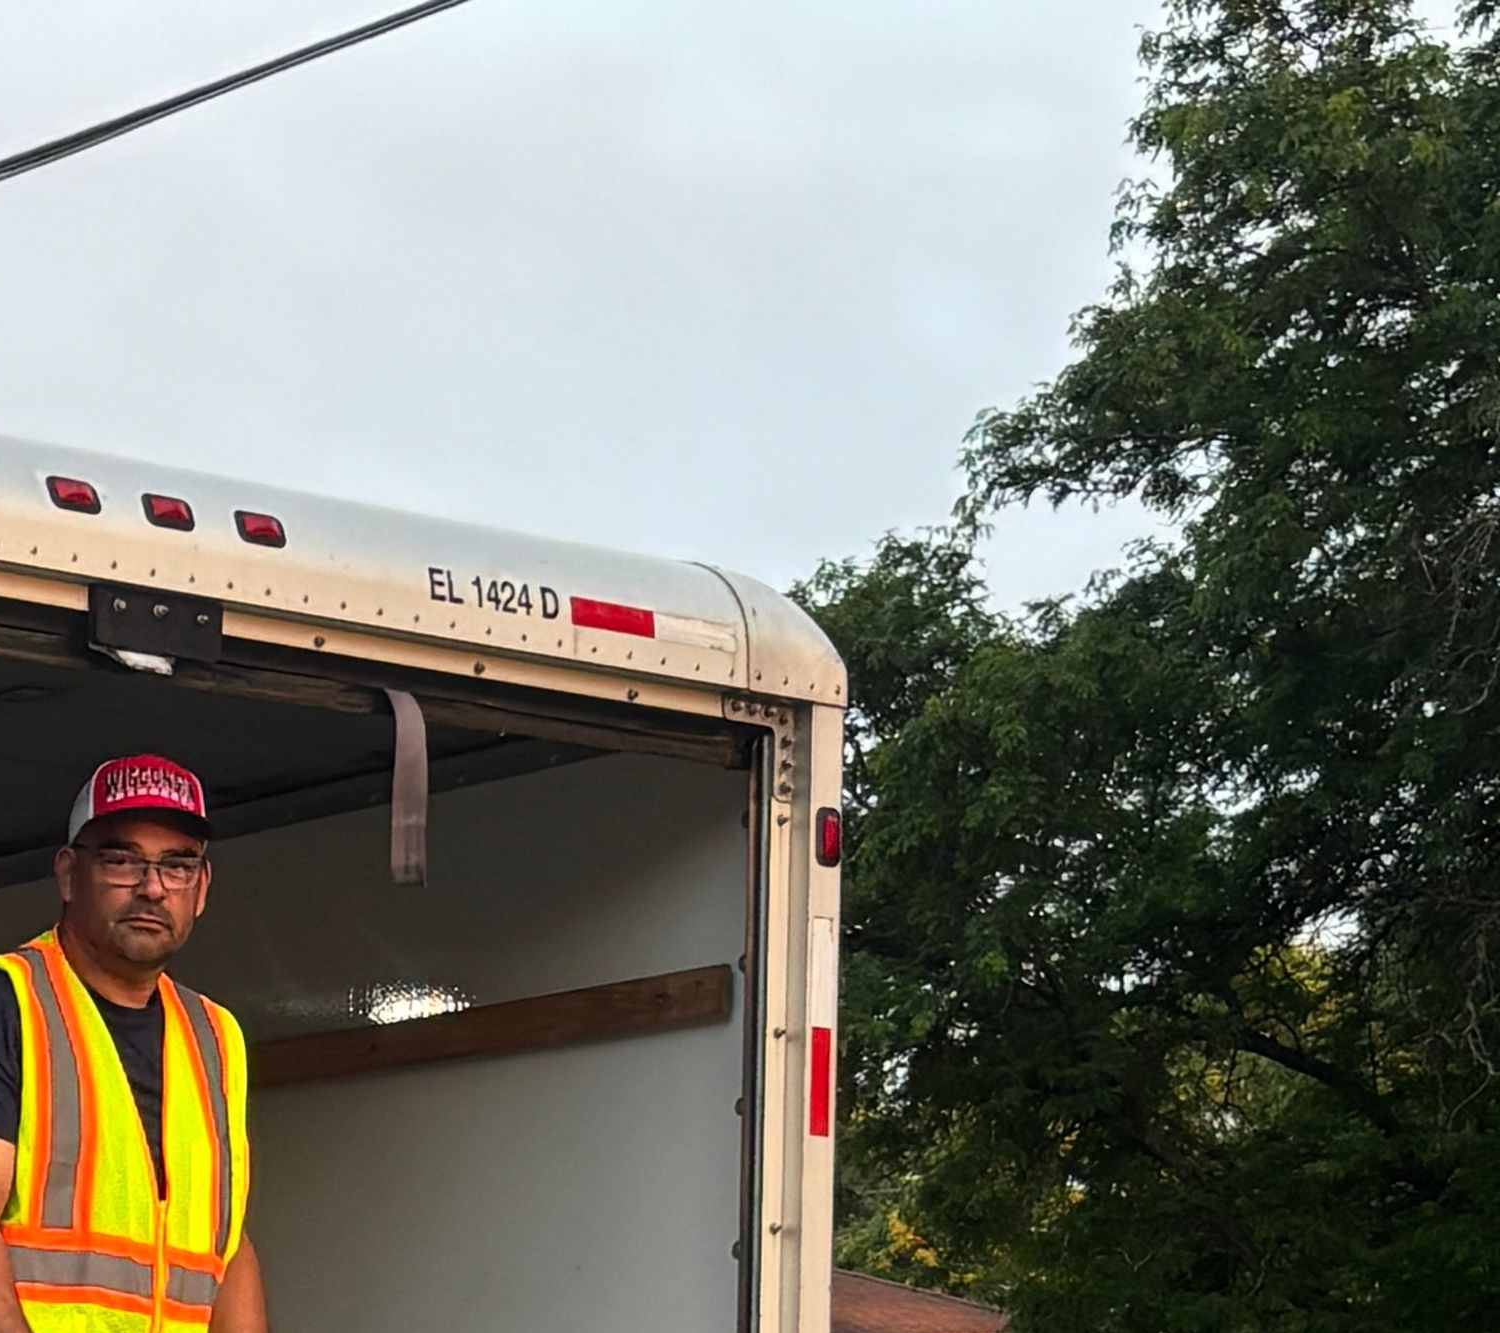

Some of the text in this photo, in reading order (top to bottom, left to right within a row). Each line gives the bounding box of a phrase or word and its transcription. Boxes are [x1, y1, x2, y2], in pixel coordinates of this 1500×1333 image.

[428, 566, 560, 619] EL 1424 D
